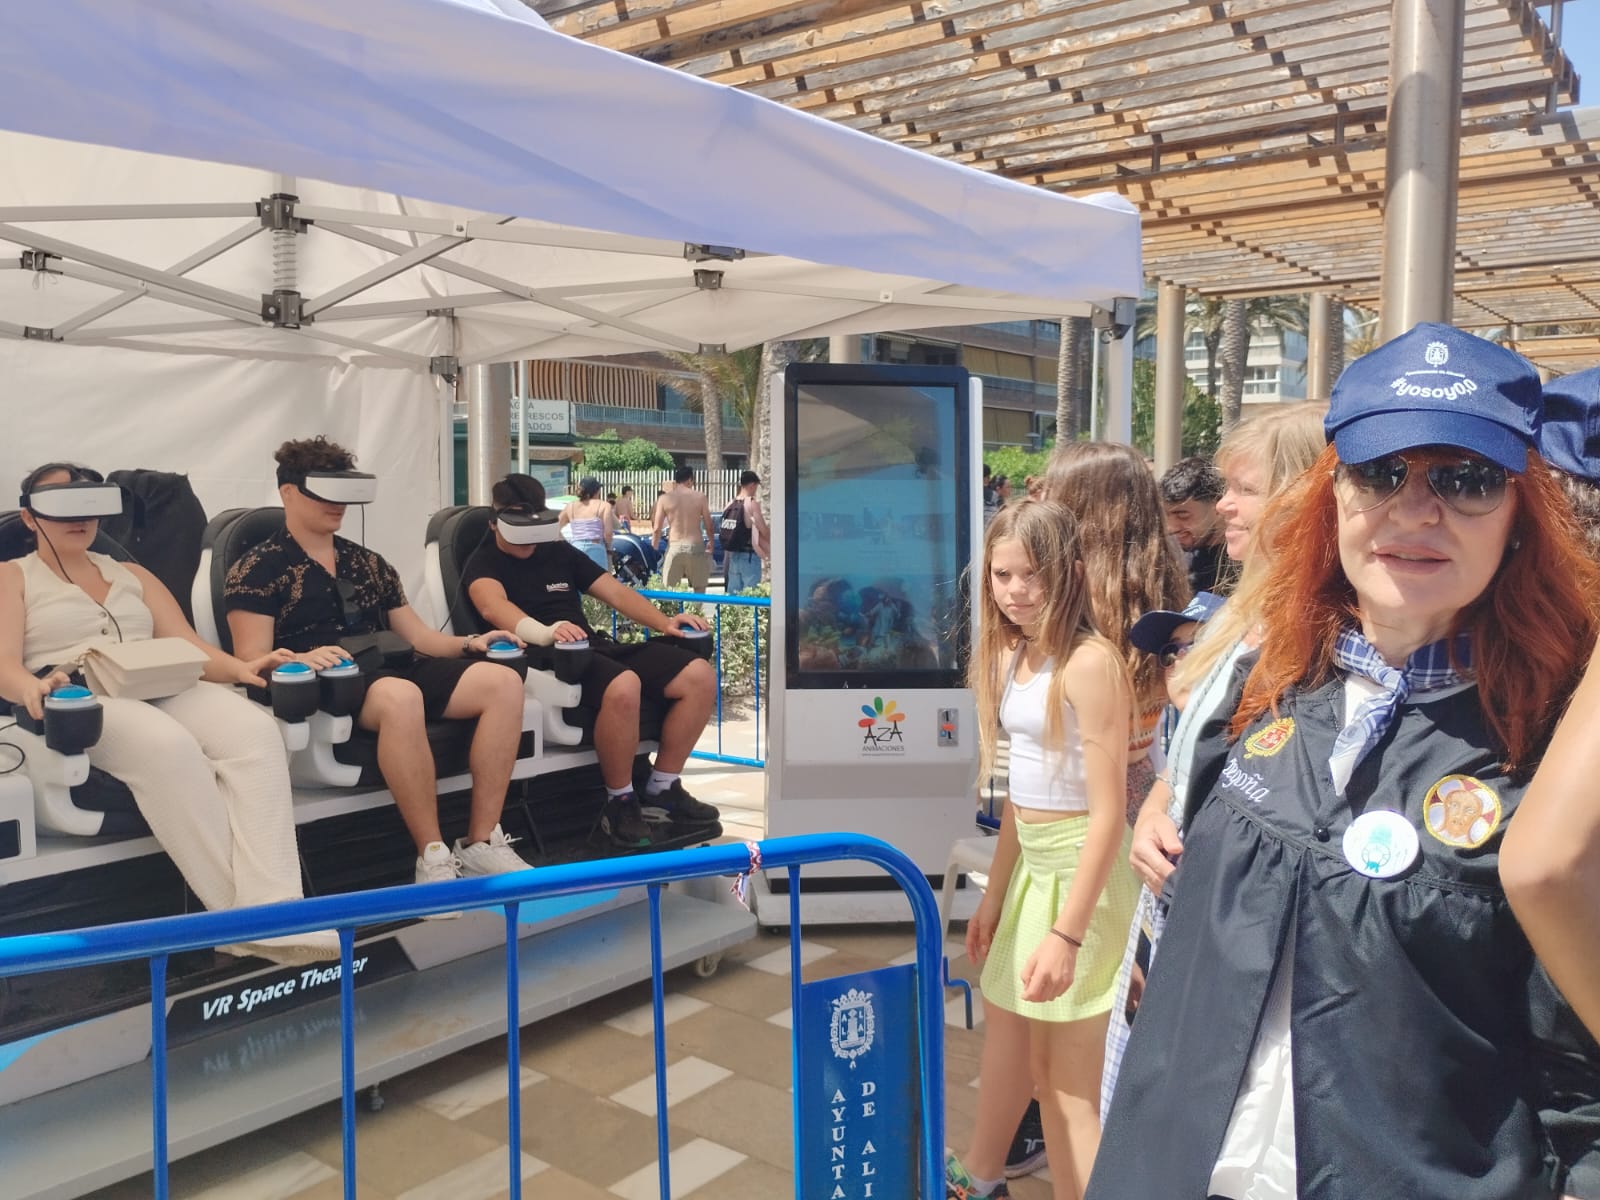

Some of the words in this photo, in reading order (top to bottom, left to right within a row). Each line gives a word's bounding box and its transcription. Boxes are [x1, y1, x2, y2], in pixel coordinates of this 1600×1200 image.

[863, 719, 903, 746] AZA
[203, 995, 233, 1020] VR
[237, 979, 296, 1012] Space
[301, 957, 368, 990] Theaer
